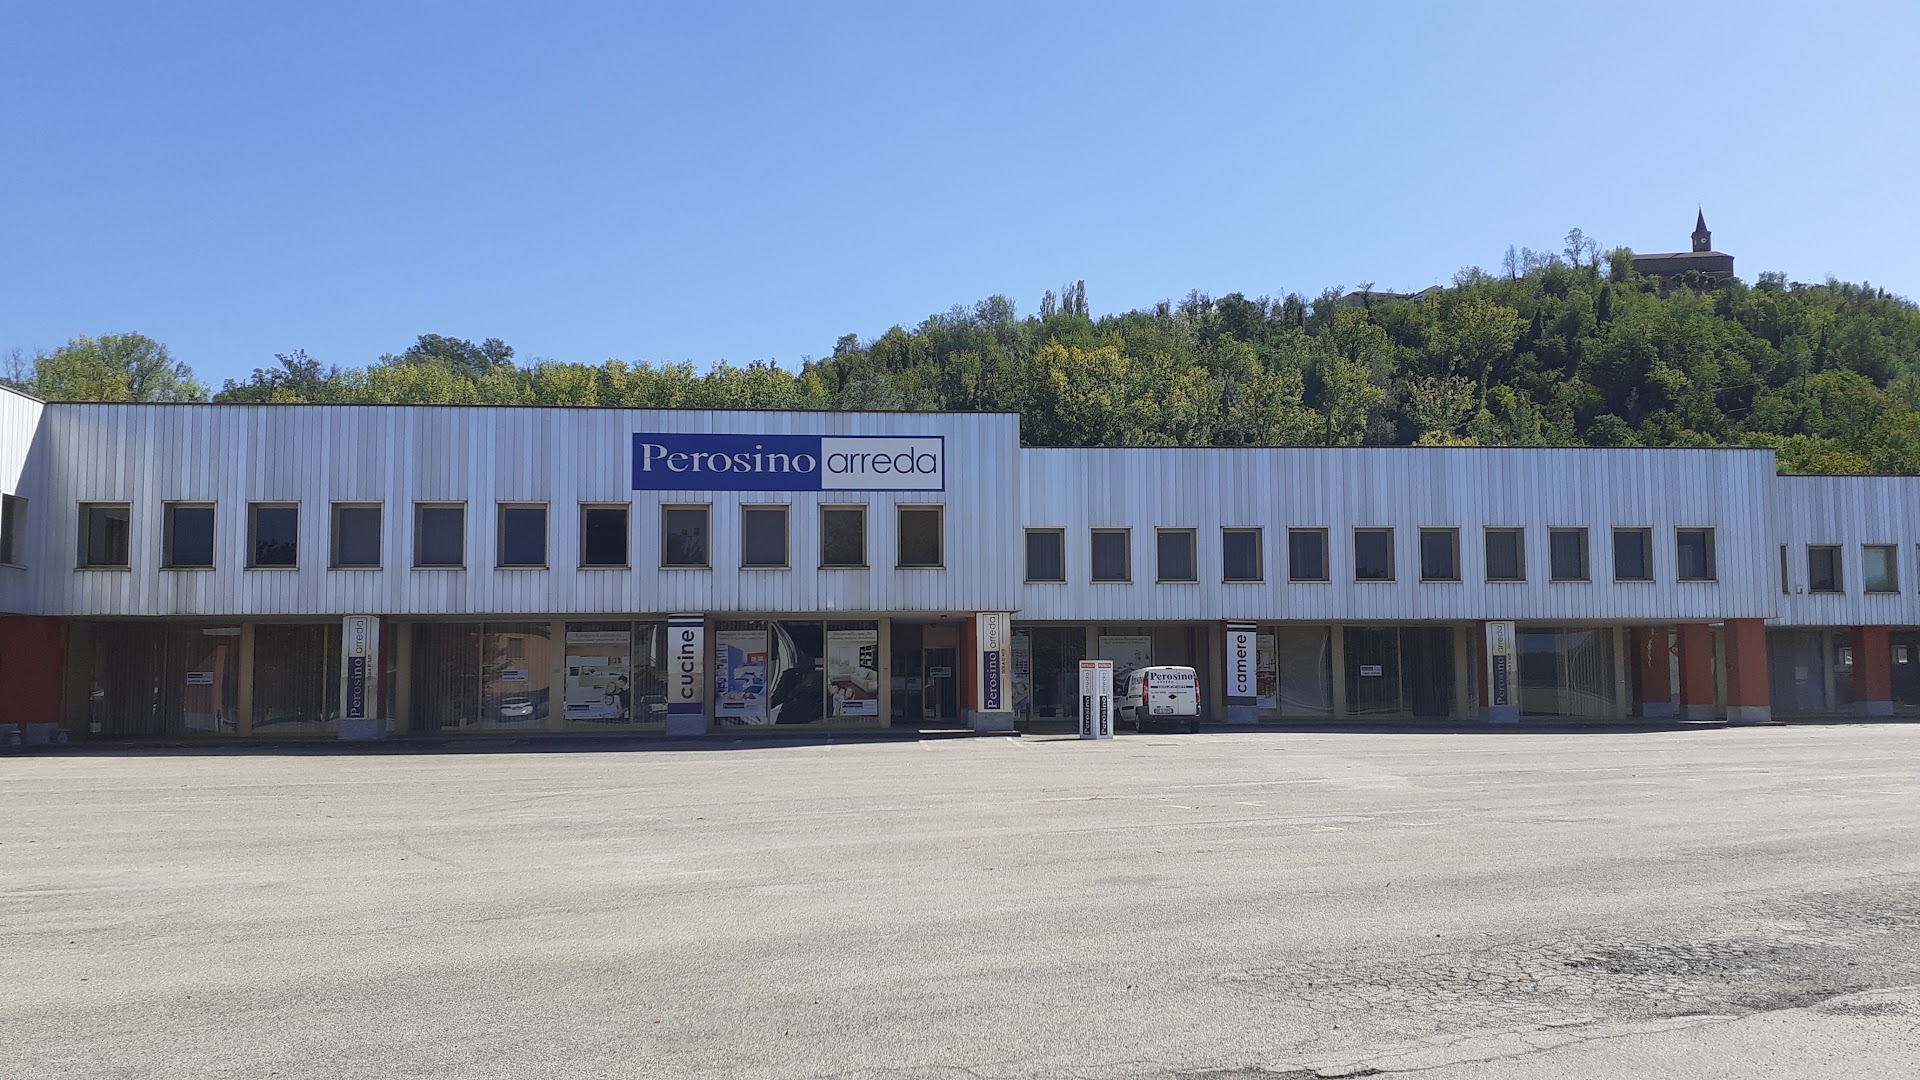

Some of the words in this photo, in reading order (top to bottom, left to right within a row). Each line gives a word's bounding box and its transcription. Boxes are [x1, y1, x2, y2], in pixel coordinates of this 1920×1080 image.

[640, 443, 817, 474] Perosino
[827, 446, 938, 474] arreda
[355, 620, 363, 653] arreda
[988, 617, 996, 648] arreda
[351, 658, 362, 716] Perosino
[677, 629, 695, 700] cucine
[987, 653, 997, 708] Perosino
[1150, 672, 1193, 680] Perosino
[1236, 634, 1248, 693] camere
[1496, 656, 1505, 704] Perosino
